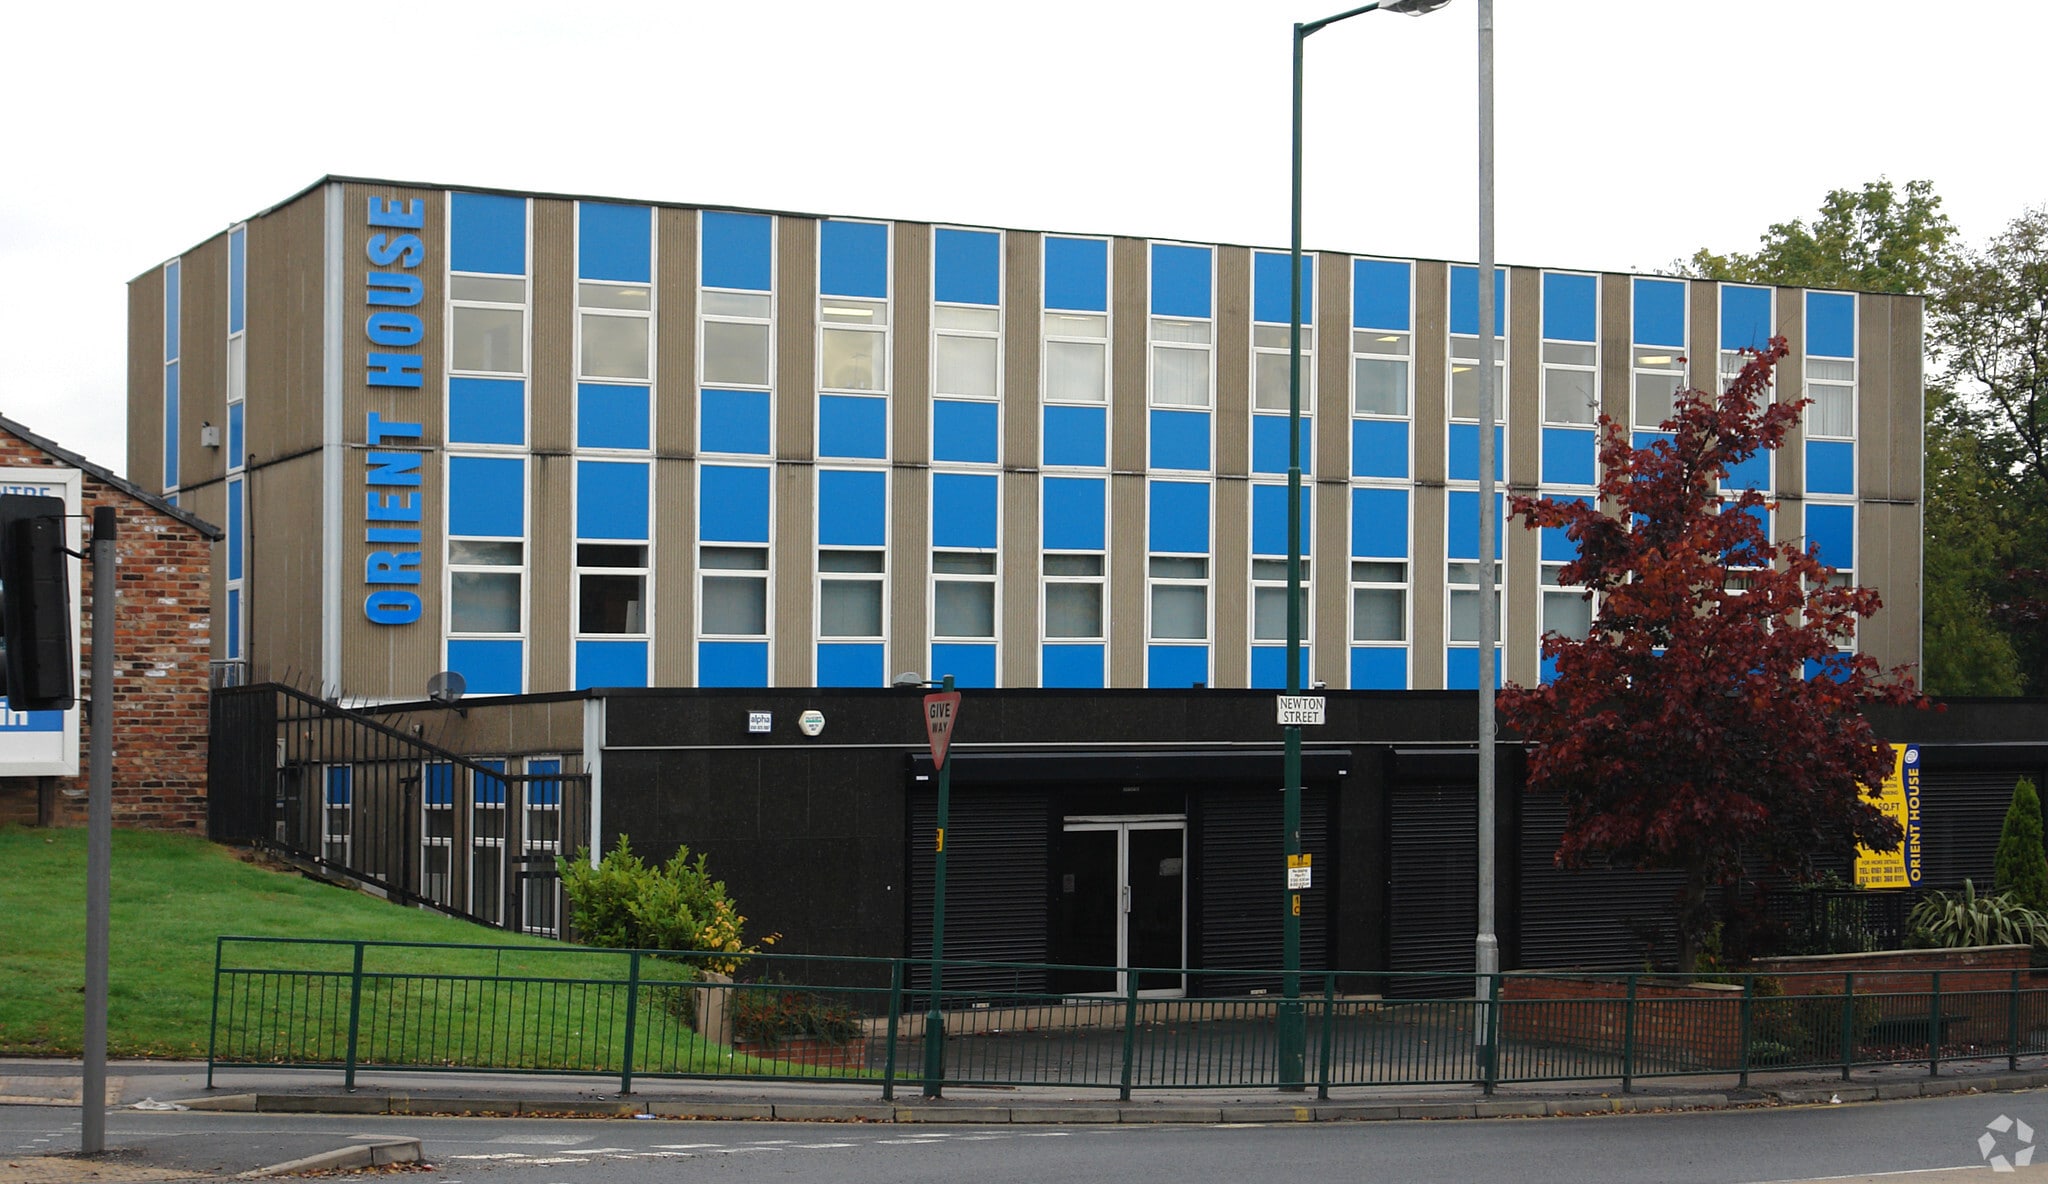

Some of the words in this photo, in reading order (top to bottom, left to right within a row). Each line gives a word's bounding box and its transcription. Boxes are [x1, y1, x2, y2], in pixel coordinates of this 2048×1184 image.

[366, 196, 425, 388] HOUSE
[364, 411, 422, 625] ORIENT
[930, 703, 950, 718] GIVE
[1280, 698, 1323, 710] NEWTON
[751, 714, 770, 725] alpha
[1284, 711, 1319, 722] STREET
[932, 721, 948, 734] WAY
[1908, 768, 1920, 820] HOUSE
[1910, 824, 1921, 882] ORIENT
